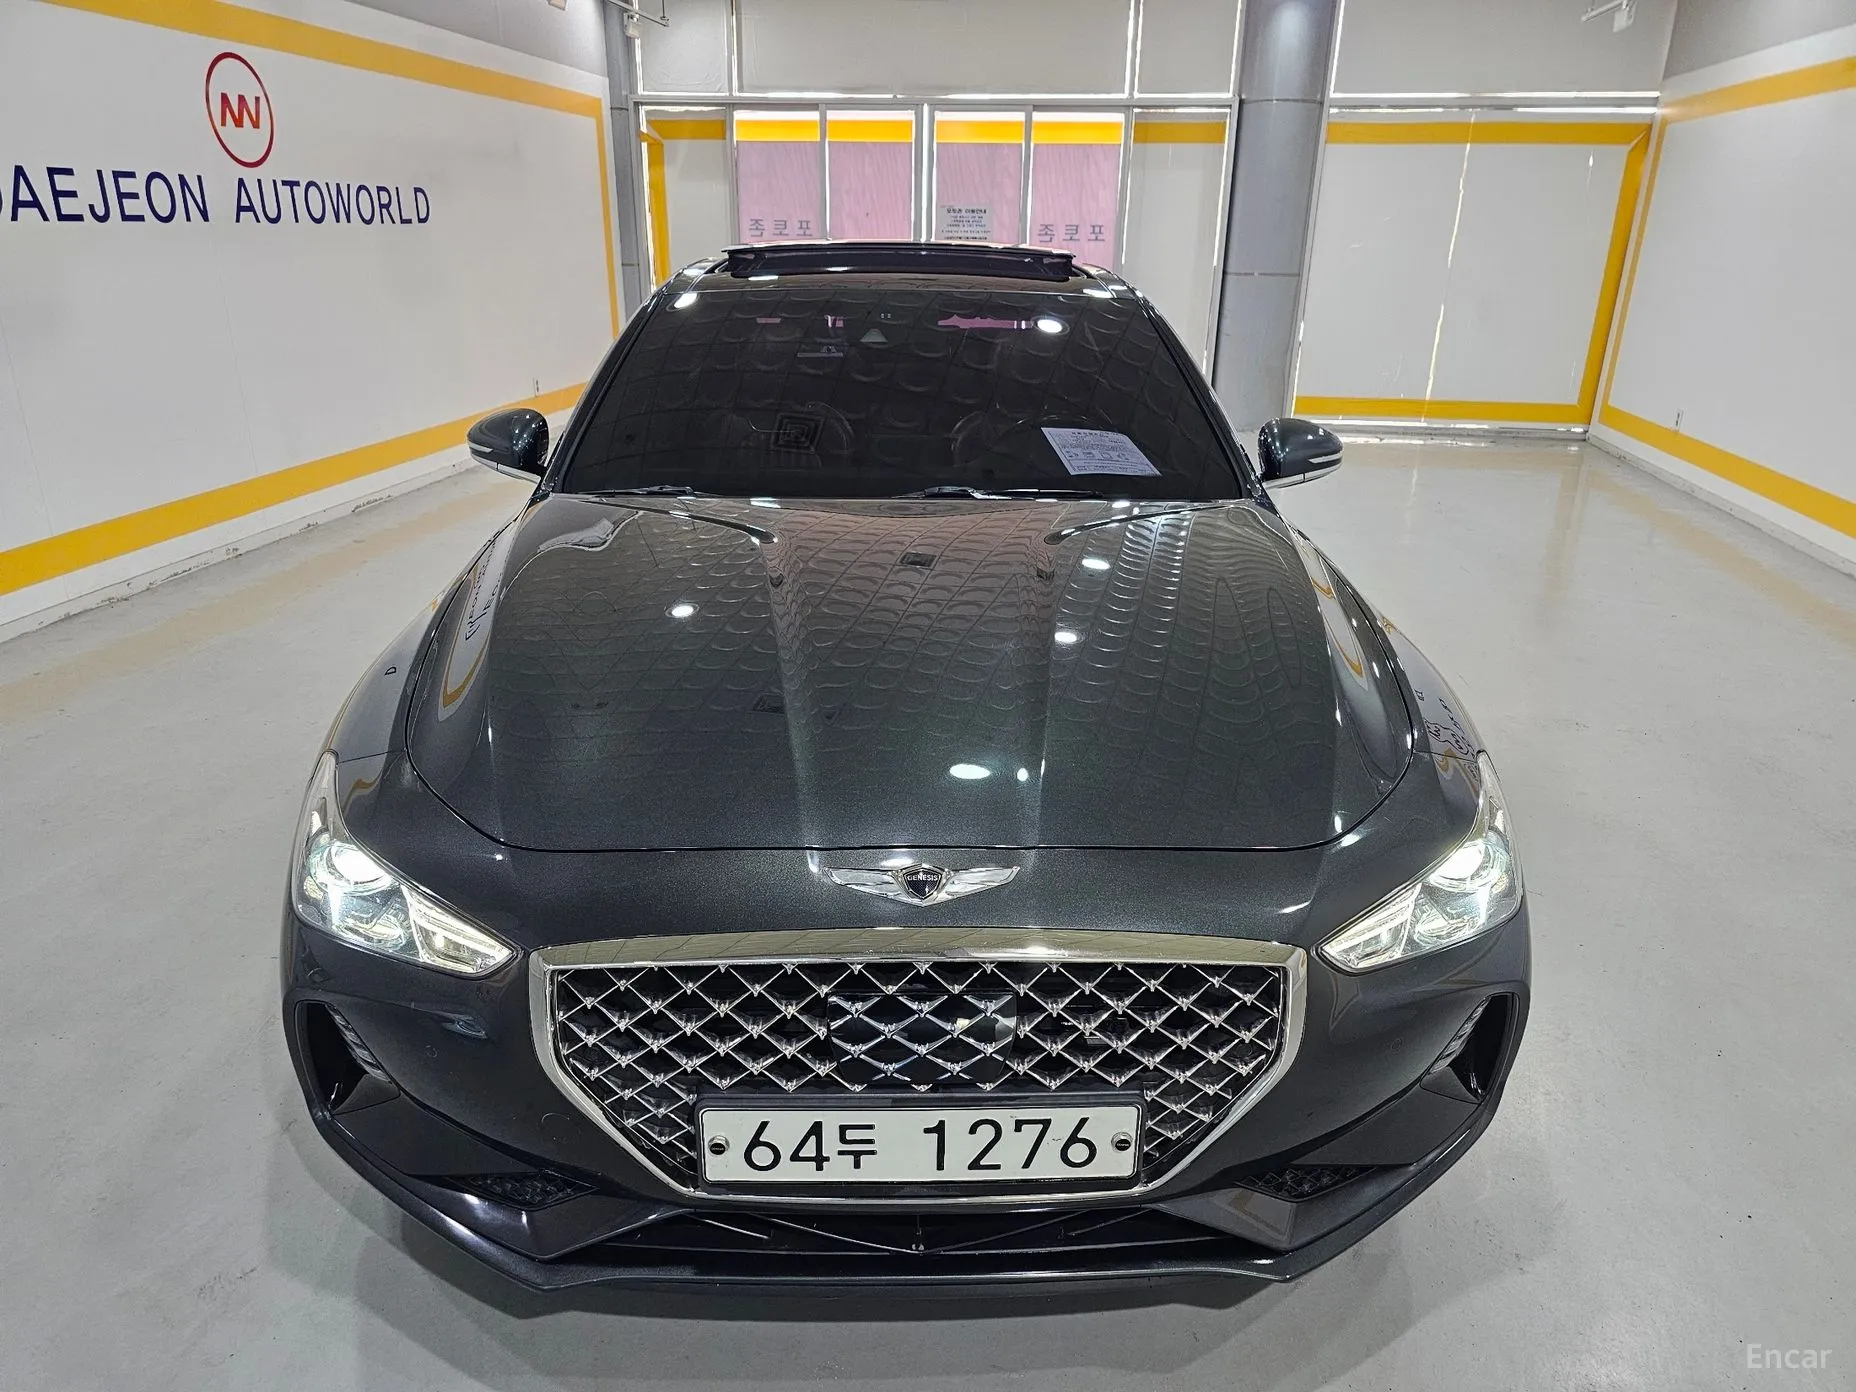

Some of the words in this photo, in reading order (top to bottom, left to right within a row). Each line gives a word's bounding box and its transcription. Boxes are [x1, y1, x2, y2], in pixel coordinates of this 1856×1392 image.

[0, 164, 210, 224] AEJEON
[235, 177, 430, 225] AUTOWORLD
[742, 1120, 878, 1172] 64두
[922, 1116, 1098, 1172] 1276
